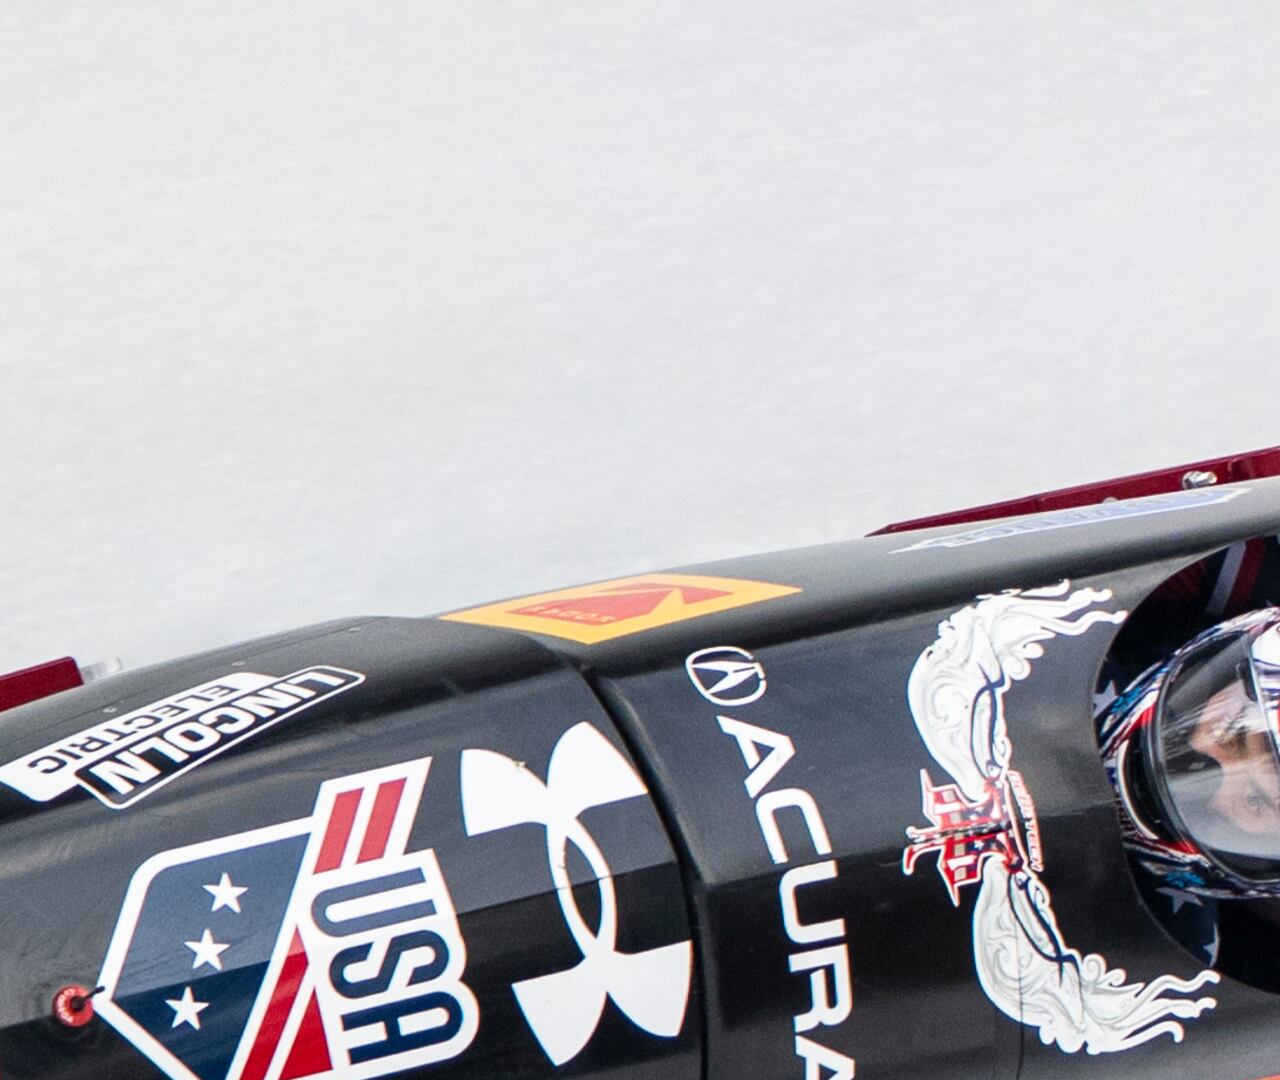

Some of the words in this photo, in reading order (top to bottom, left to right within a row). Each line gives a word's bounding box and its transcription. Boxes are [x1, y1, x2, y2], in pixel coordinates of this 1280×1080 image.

[28, 684, 243, 775] ELECTRIC
[90, 671, 345, 796] LINCOLN
[311, 868, 463, 1062] USA
